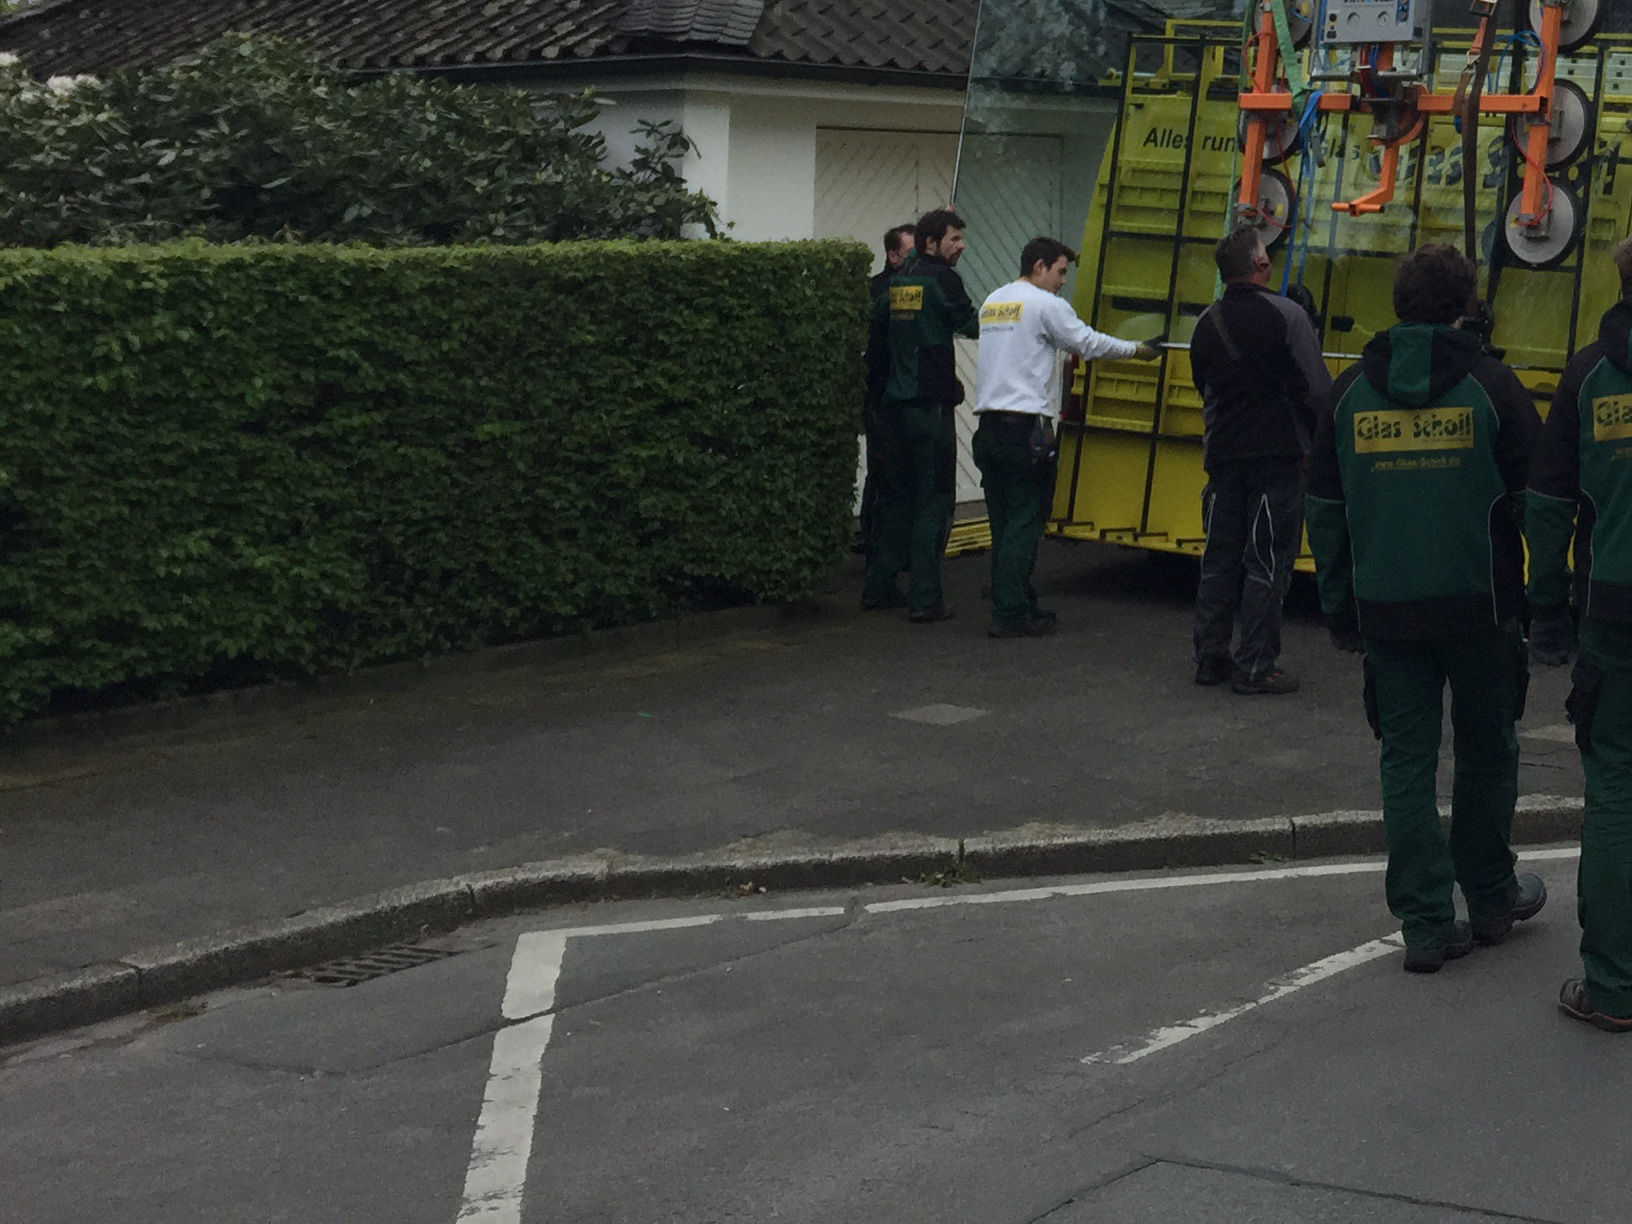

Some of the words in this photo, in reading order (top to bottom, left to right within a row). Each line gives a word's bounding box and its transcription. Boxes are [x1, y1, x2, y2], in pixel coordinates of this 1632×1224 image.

[1201, 135, 1237, 153] run
[1357, 415, 1402, 440] Glas
[1413, 412, 1471, 438] Scholl
